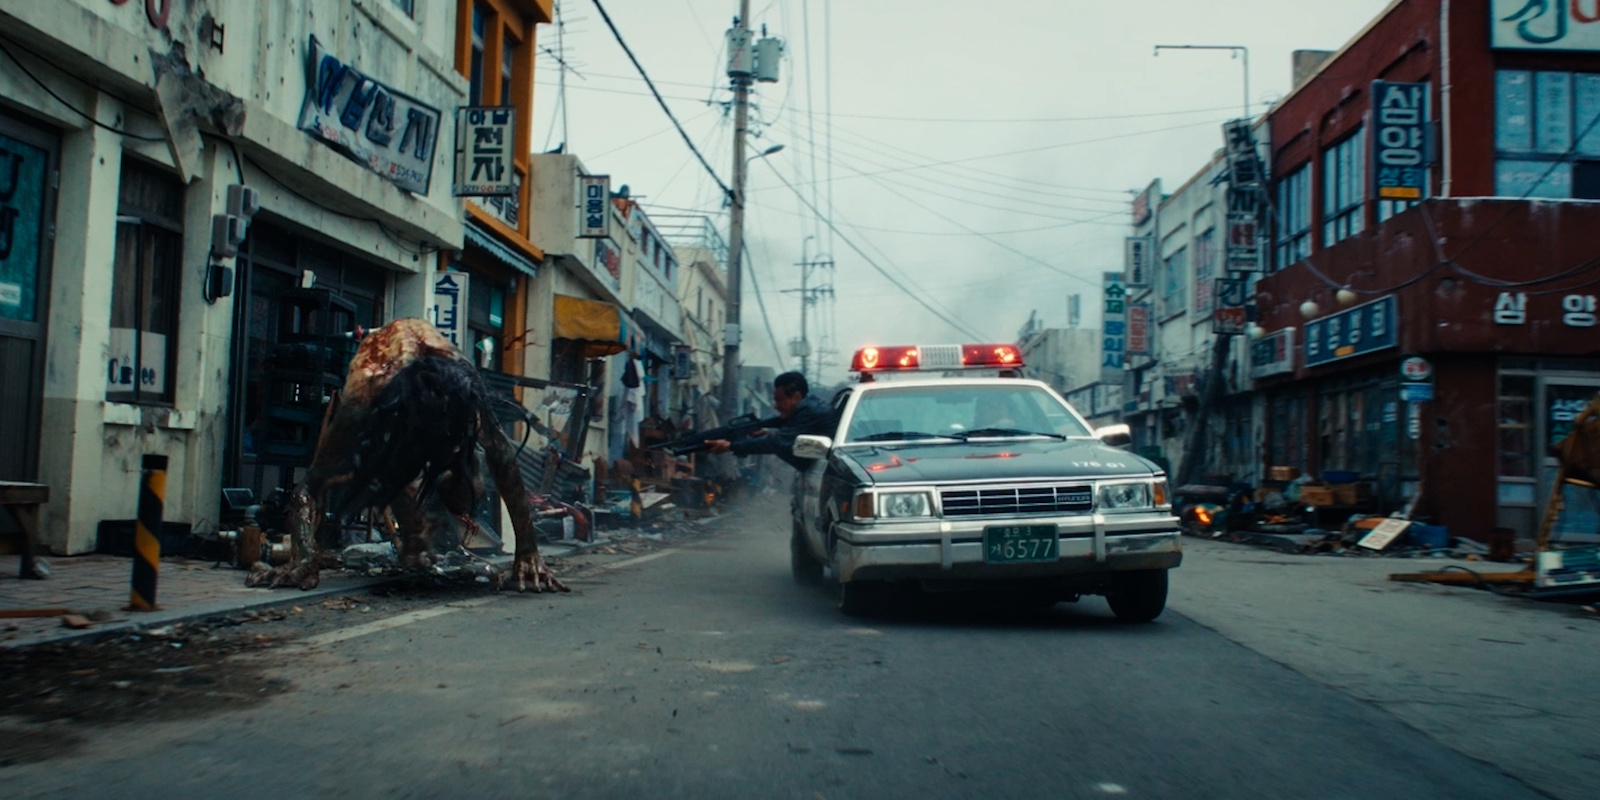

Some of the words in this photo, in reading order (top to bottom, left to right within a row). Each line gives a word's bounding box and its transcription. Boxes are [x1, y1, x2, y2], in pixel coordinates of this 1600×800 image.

[1379, 86, 1422, 165] 삼양
[470, 127, 504, 182] 전자
[587, 184, 604, 229] 미용실
[1004, 538, 1053, 559] 6577
[1025, 526, 1032, 536] 3
